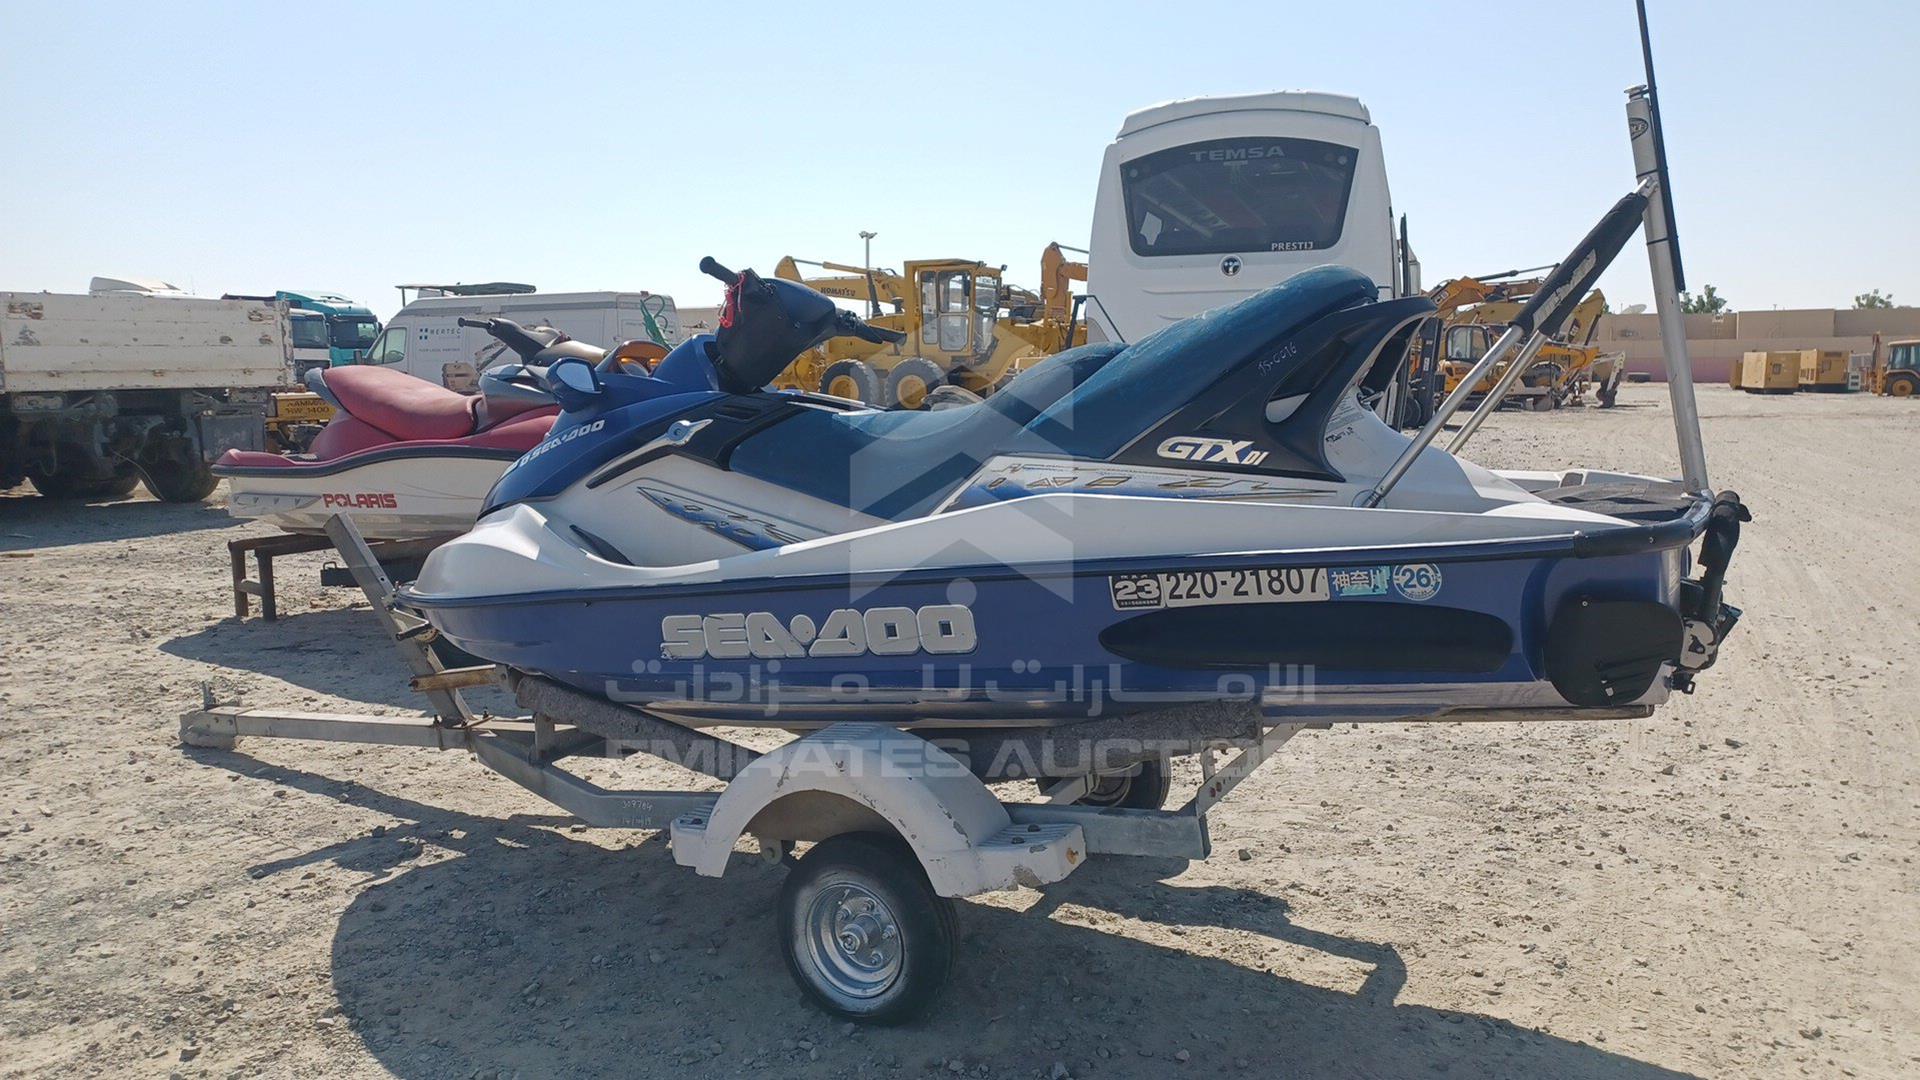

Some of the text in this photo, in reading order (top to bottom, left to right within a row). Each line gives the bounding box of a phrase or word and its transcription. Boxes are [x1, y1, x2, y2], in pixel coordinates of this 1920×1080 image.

[1190, 146, 1285, 162] TEMSA
[1271, 241, 1314, 252] PRESTIJ
[820, 287, 856, 297] KOMATSU
[1156, 435, 1255, 464] GTX
[322, 493, 398, 508] POLARIS
[1165, 567, 1321, 600] 220-21807
[1401, 567, 1432, 589] 26
[1115, 580, 1160, 601] 23
